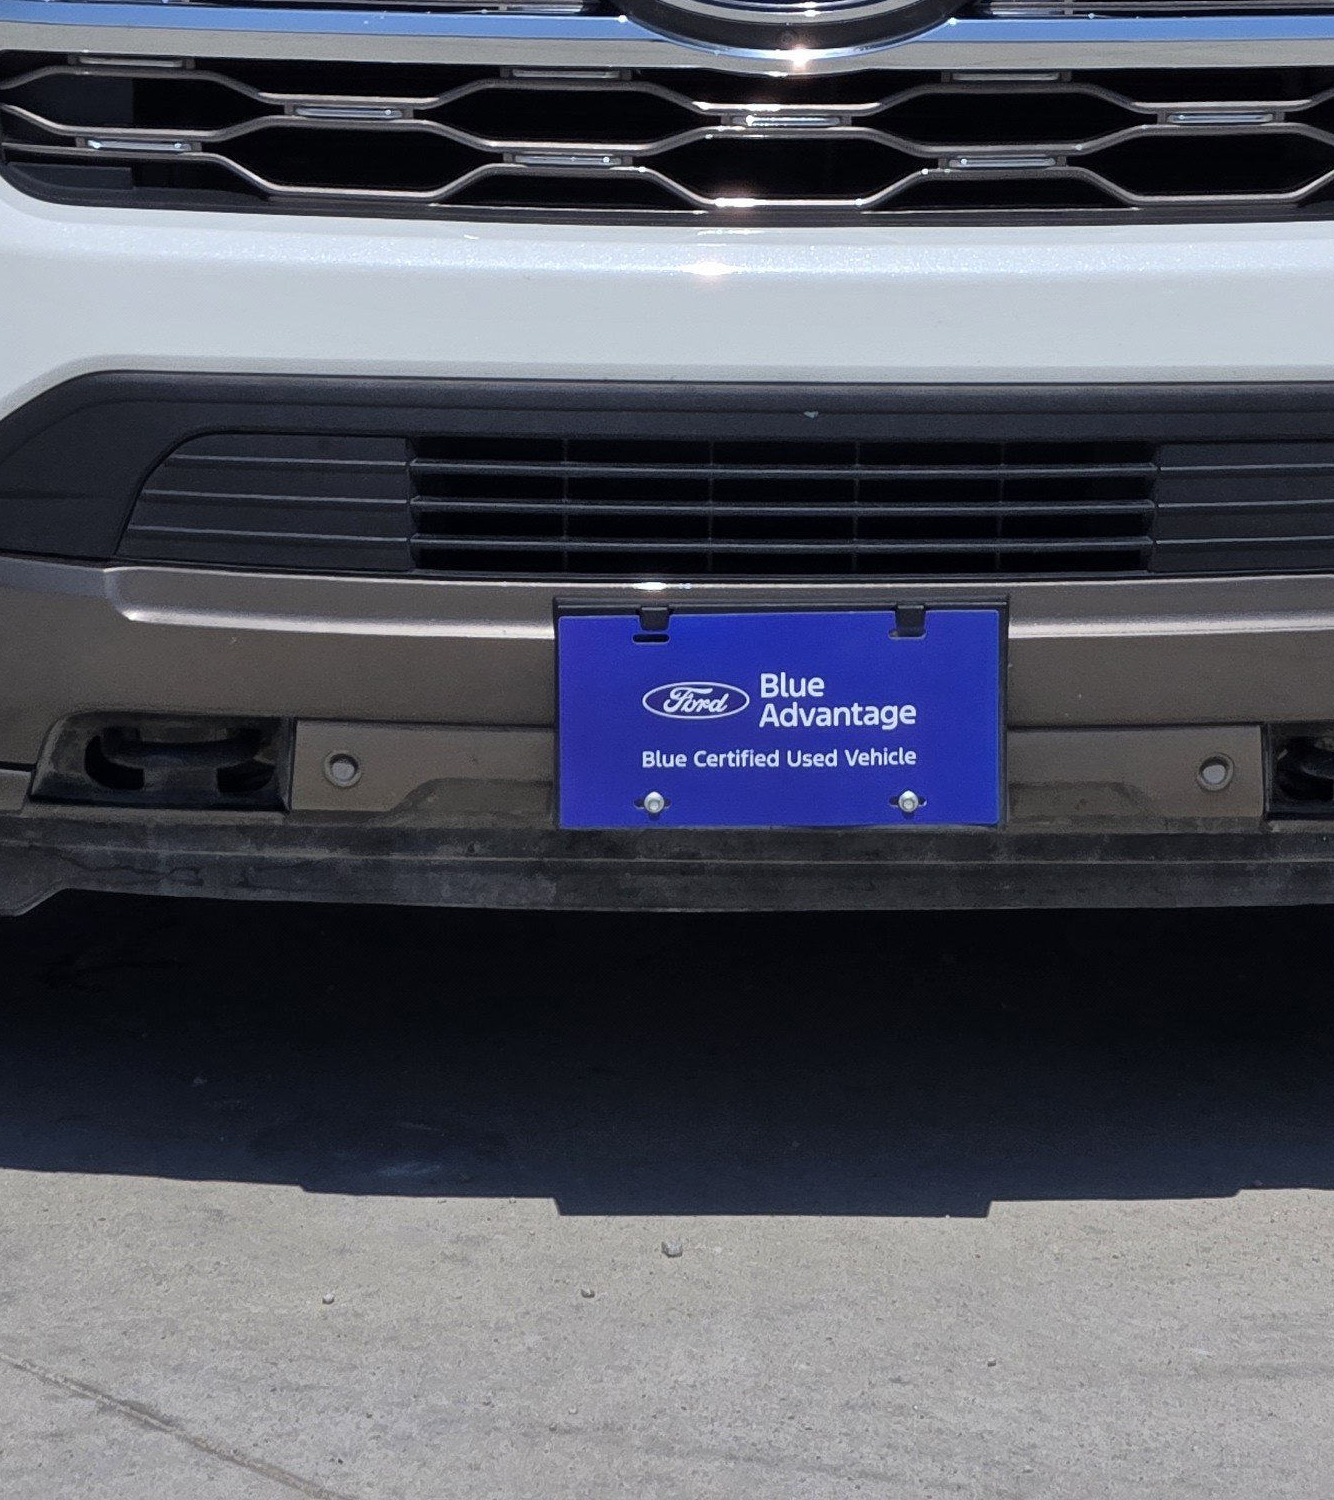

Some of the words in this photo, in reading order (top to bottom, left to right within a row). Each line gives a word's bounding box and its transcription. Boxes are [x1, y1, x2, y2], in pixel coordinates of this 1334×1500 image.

[759, 672, 825, 699] Blue
[662, 687, 729, 714] Ford
[758, 702, 917, 731] Advantage
[642, 750, 687, 768] Blue
[693, 749, 780, 768] Certified
[786, 749, 838, 767] Used
[844, 747, 917, 766] Vehicle
